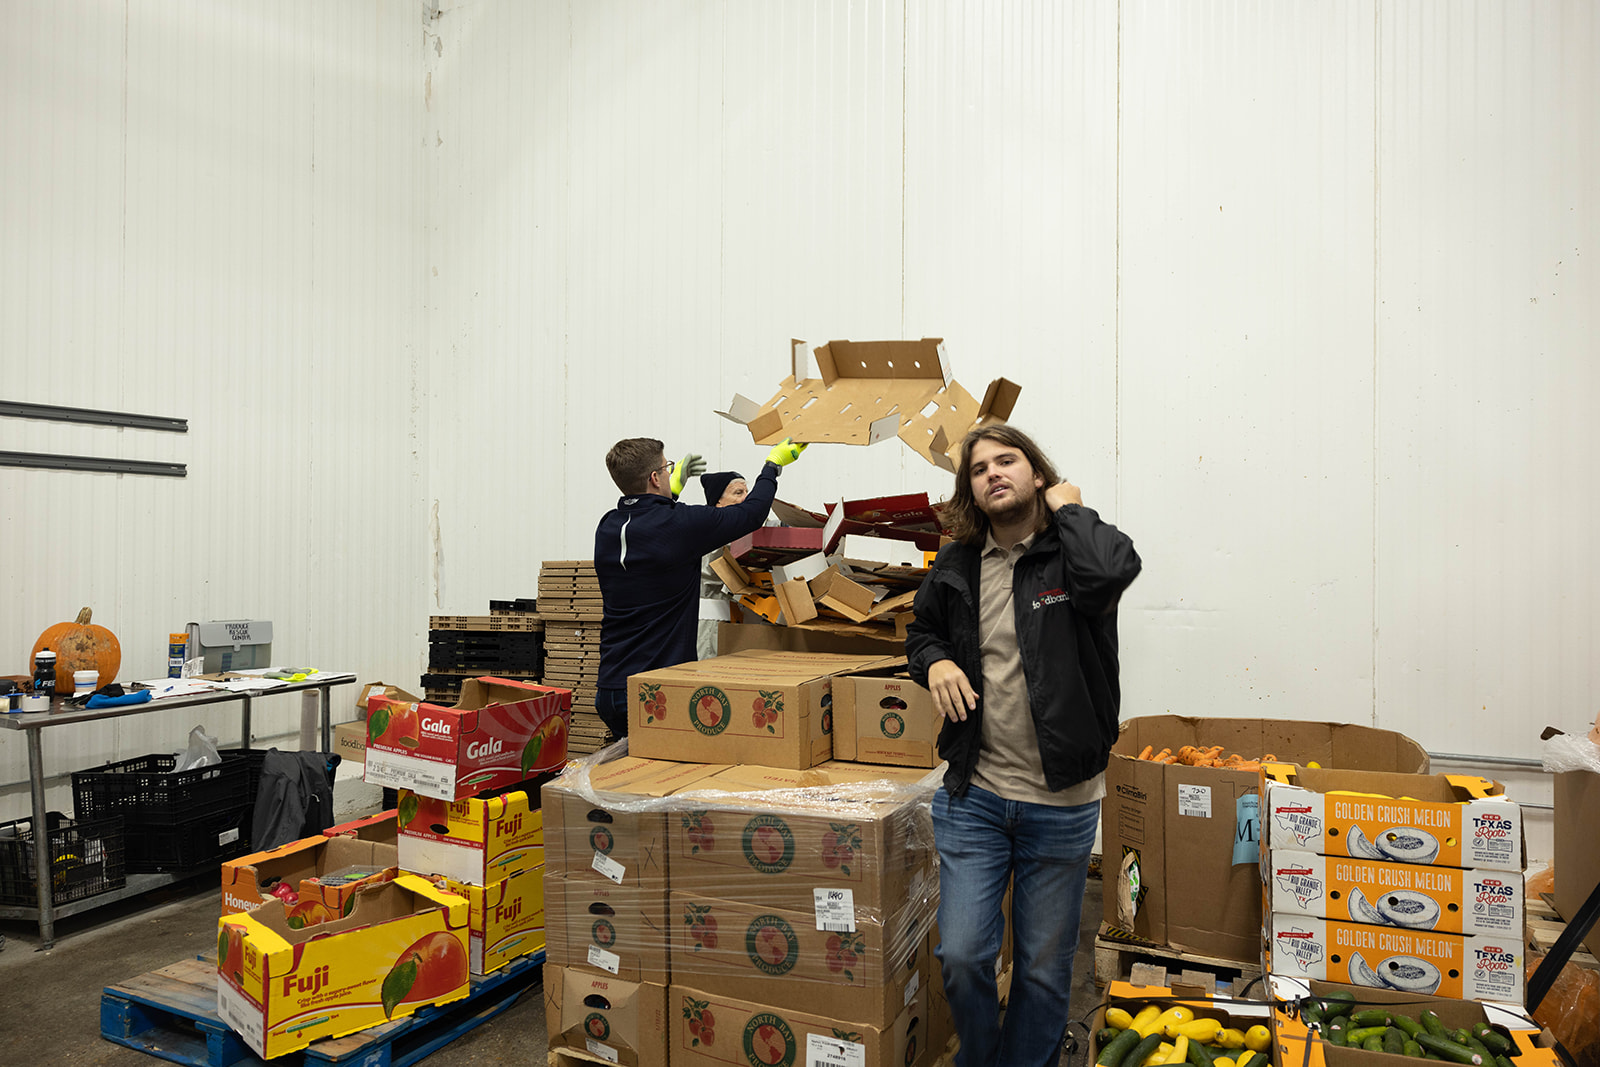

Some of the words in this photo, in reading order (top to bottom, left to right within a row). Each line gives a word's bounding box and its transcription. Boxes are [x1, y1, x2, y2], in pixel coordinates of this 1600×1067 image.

[892, 511, 924, 519] Gala
[691, 687, 715, 704] NORTH
[717, 691, 728, 706] BAY
[421, 718, 451, 734] Gala
[694, 720, 725, 735] PRODUCE
[373, 743, 392, 751] PREMIUM
[467, 737, 502, 760] Gala
[450, 801, 470, 817] Fuji
[1335, 802, 1373, 821] GOLDEN
[1378, 805, 1410, 824] CRUSH
[1414, 808, 1450, 828] MELON
[496, 812, 522, 838] Fuji
[1289, 814, 1298, 823] RIO
[1299, 816, 1318, 828] GRANDE
[1473, 818, 1512, 830] TEXAS
[1294, 824, 1310, 835] VALLEY
[1475, 826, 1506, 839] Roots
[1291, 876, 1299, 885] RIO
[1300, 878, 1319, 890] GRANDE
[1336, 864, 1374, 884] GOLDEN
[1379, 868, 1411, 888] CRUSH
[1415, 872, 1452, 892] MELON
[1296, 886, 1312, 896] VALLEY
[1474, 883, 1513, 896] TEXAS
[1476, 892, 1507, 904] Roots
[495, 897, 522, 924] Fuji
[750, 916, 778, 935] NORTH
[1291, 939, 1300, 948] RIO
[1300, 941, 1319, 954] GRANDE
[1337, 928, 1375, 948] GOLDEN
[1379, 933, 1412, 953] CRUSH
[1416, 938, 1452, 958] MELON
[245, 945, 256, 969] Fuji
[1296, 949, 1312, 960] VALLEY
[1474, 950, 1514, 963] TEXAS
[752, 954, 792, 974] PRODUCE
[1477, 958, 1508, 971] Roots
[283, 965, 329, 997] Fuji
[591, 981, 608, 990] APPLES
[747, 1015, 776, 1032] NORTH
[779, 1023, 793, 1042] BAY
